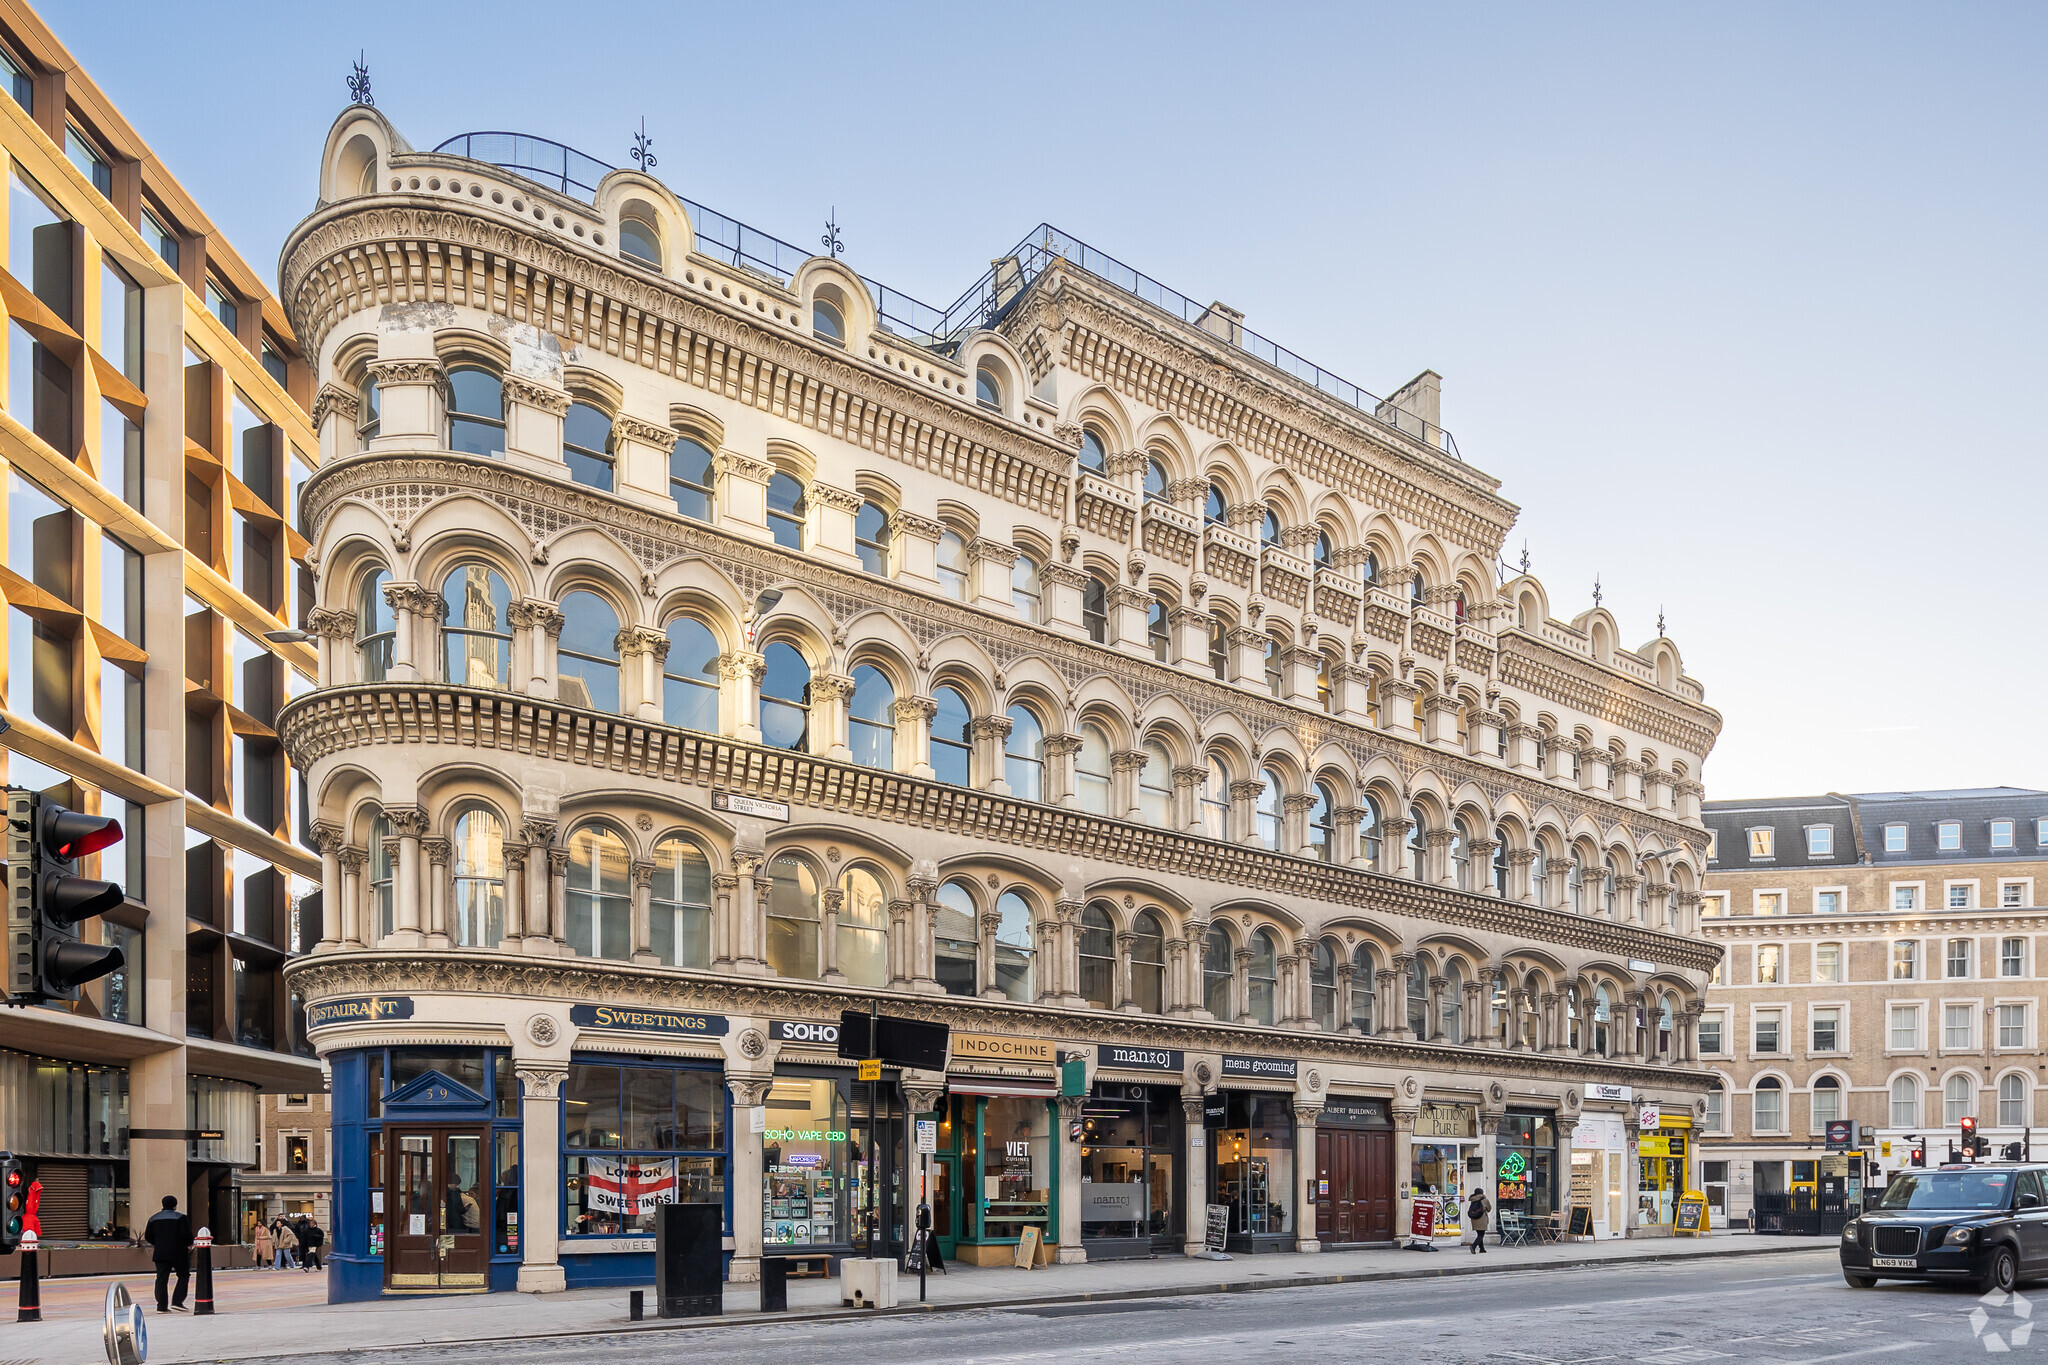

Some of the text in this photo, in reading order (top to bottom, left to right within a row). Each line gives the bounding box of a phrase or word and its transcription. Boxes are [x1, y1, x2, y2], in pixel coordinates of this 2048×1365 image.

[733, 804, 753, 813] STREET
[734, 798, 782, 812] QUEEN VICTORIA
[310, 1000, 398, 1025] RESTAURANT
[594, 1007, 707, 1030] SWEETINGS
[782, 1022, 838, 1042] SOHO
[960, 1039, 1047, 1057] INDOCHINE
[1225, 1059, 1295, 1075] mens grooming
[1326, 1106, 1377, 1116] ALBERT BUILDINGS
[1420, 1102, 1475, 1121] TRADITIONAL
[764, 1129, 847, 1141] SOHO VAPE CBD
[1432, 1119, 1459, 1135] PURE
[1005, 1140, 1030, 1157] VIET
[605, 1165, 662, 1179] LONDON
[769, 1164, 803, 1173] RELX
[597, 1193, 672, 1209] SWEETINGS
[763, 1236, 788, 1244] RELX
[1898, 1259, 1914, 1267] VHX
